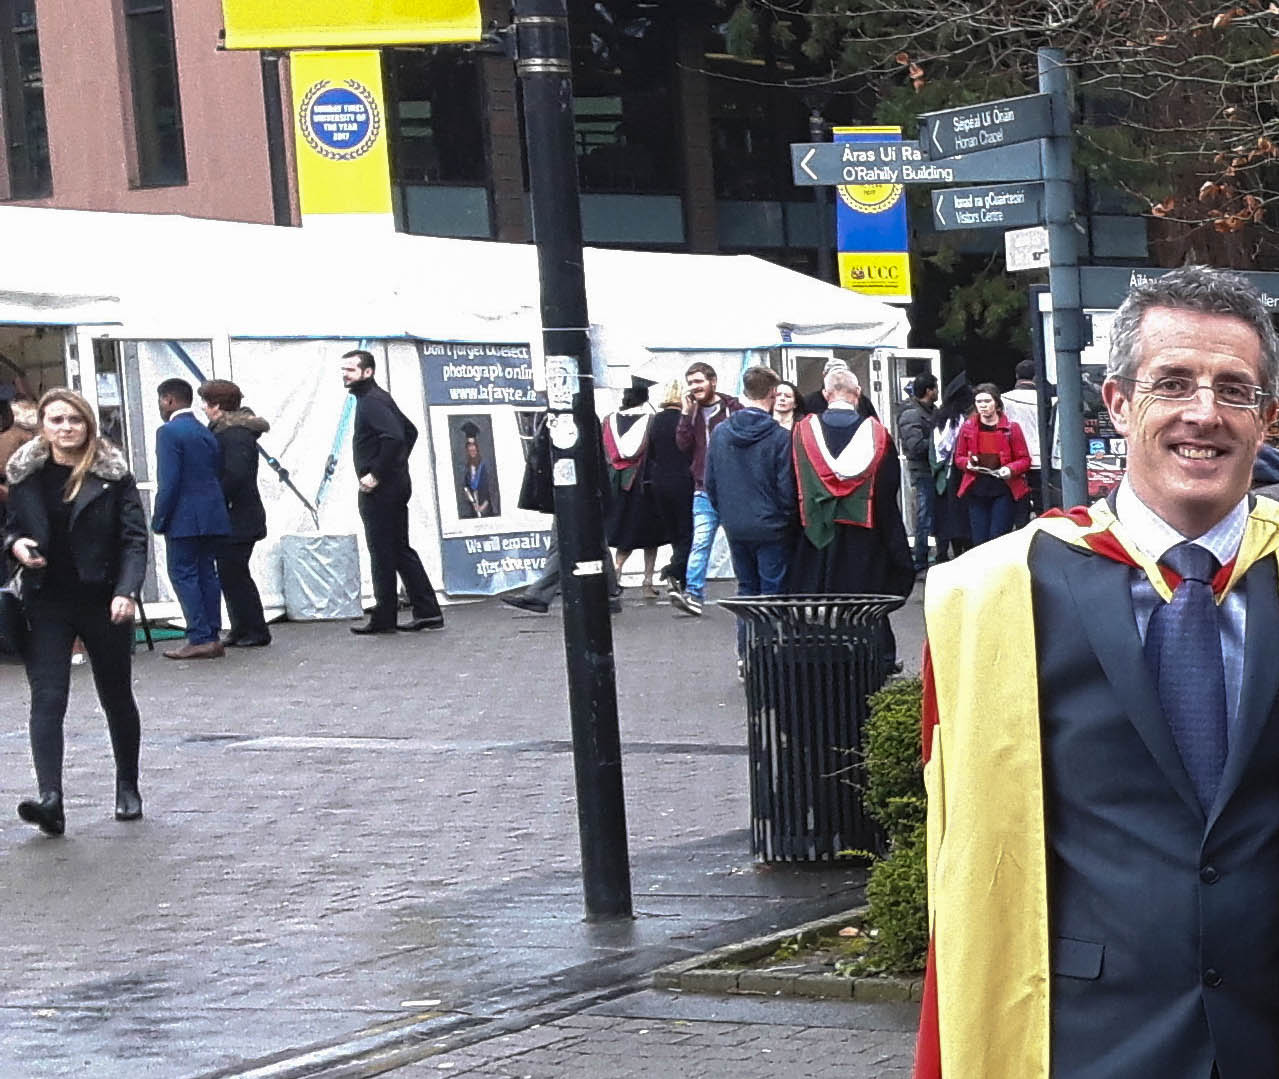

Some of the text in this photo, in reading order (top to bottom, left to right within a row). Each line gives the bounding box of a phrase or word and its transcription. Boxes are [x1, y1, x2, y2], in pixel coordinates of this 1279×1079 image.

[903, 165, 953, 182] Building
[867, 265, 899, 279] UCC
[502, 533, 539, 550] email
